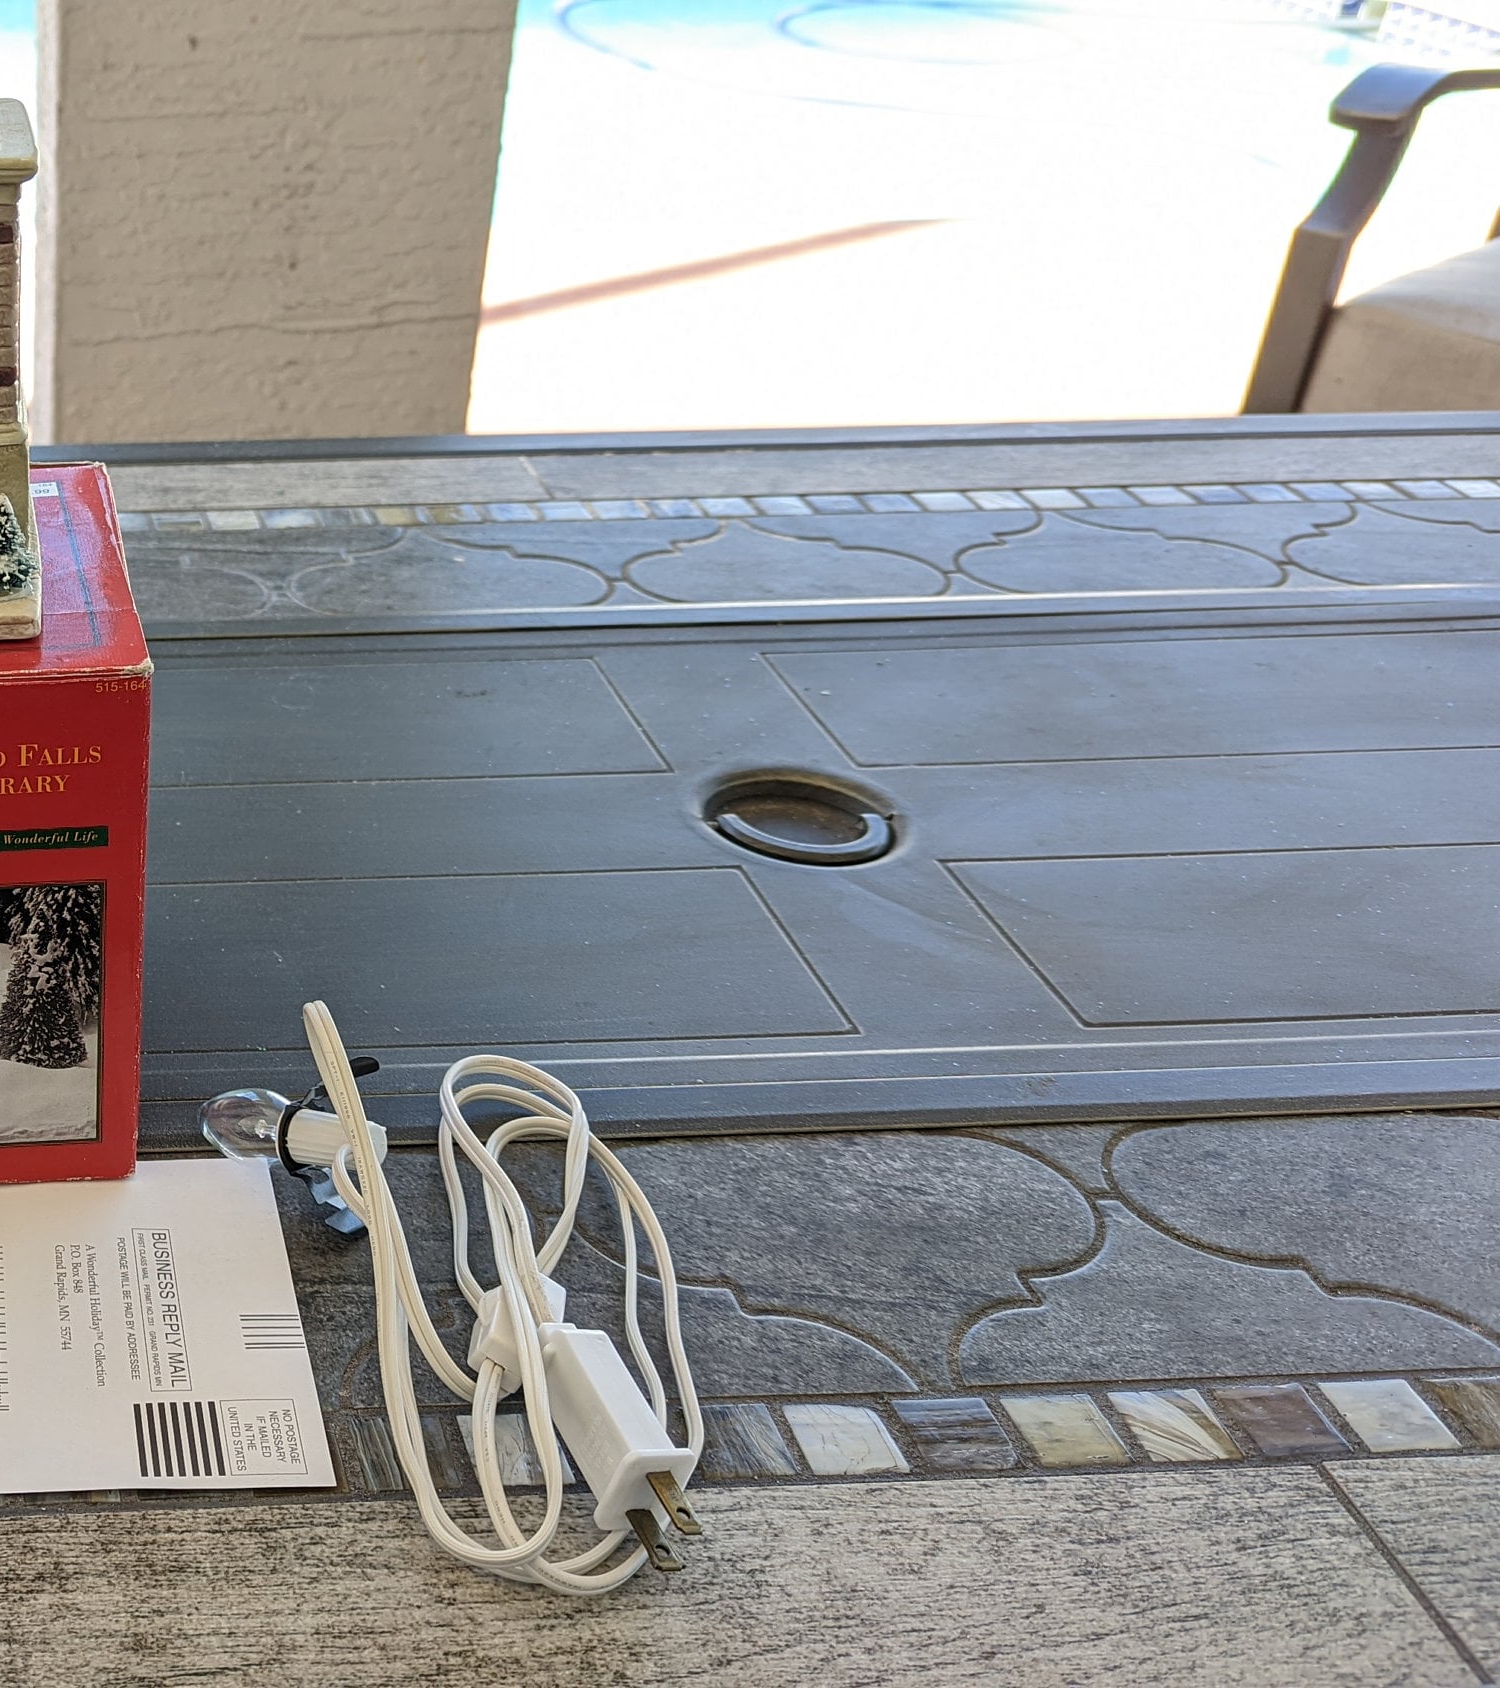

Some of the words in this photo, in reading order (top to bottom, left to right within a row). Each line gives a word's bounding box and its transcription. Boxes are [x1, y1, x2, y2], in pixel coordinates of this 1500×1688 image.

[95, 680, 147, 692] 515-164
[17, 744, 102, 767] FALLS
[3, 832, 69, 845] Wonderful
[74, 830, 99, 843] Life
[138, 1232, 146, 1248] FIRST
[54, 1244, 66, 1270] Grand
[70, 1244, 80, 1260] P.O.
[117, 1237, 128, 1270] POSTAGE
[139, 1248, 148, 1267] CLASS
[72, 1262, 82, 1278] Box
[152, 1232, 176, 1299] BUSINESS
[54, 1272, 68, 1303] Rapids,
[73, 1280, 84, 1294] 848
[120, 1271, 130, 1288] WILL
[122, 1290, 132, 1300] BE
[144, 1284, 152, 1305] PERMIT
[59, 1304, 70, 1322] MN
[86, 1253, 100, 1296] Wonderful
[94, 1342, 106, 1387] Collection
[124, 1302, 134, 1318] PAID
[126, 1320, 135, 1330] BY
[161, 1304, 182, 1348] REPLY
[60, 1326, 72, 1350] 55744
[148, 1331, 158, 1352] GRAND
[126, 1332, 140, 1380] ADDRESSEE
[152, 1352, 161, 1376] RAPIDS
[168, 1352, 187, 1388] MAIL
[155, 1376, 162, 1386] MN
[228, 1406, 241, 1438] UNITED
[256, 1416, 266, 1424] IF
[282, 1409, 292, 1422] NO
[244, 1423, 254, 1432] IN
[268, 1410, 286, 1463] NECESSARY
[246, 1434, 257, 1452] THE
[258, 1426, 272, 1458] MAILED
[284, 1424, 300, 1464] POSTAGE
[233, 1440, 247, 1472] STATES
